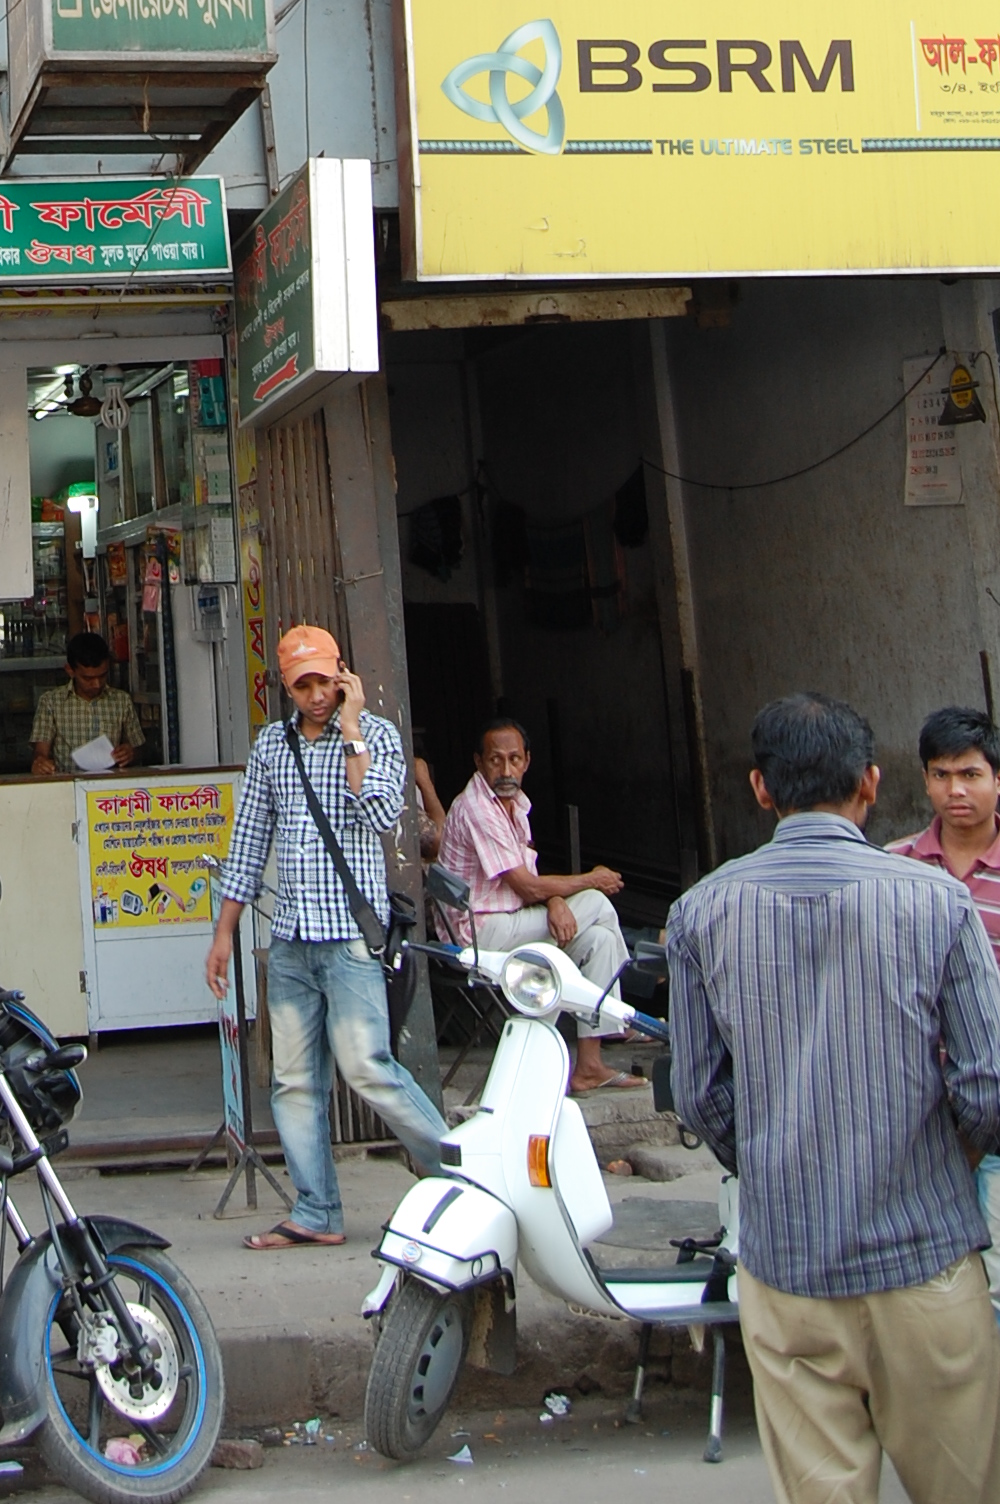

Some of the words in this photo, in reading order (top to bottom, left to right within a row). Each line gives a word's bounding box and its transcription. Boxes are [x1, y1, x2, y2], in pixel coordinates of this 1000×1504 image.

[576, 39, 856, 93] BSRM
[656, 139, 694, 155] THE
[700, 138, 793, 156] ULTIMATE
[798, 138, 859, 154] STEEL
[29, 187, 212, 232] ফার্মেসী
[25, 239, 96, 265] ঔষধ
[100, 245, 124, 267] সুলভ
[152, 242, 179, 261] পাওয়া
[156, 784, 222, 812] ফার্মেসী
[129, 850, 170, 879] ঔষধ
